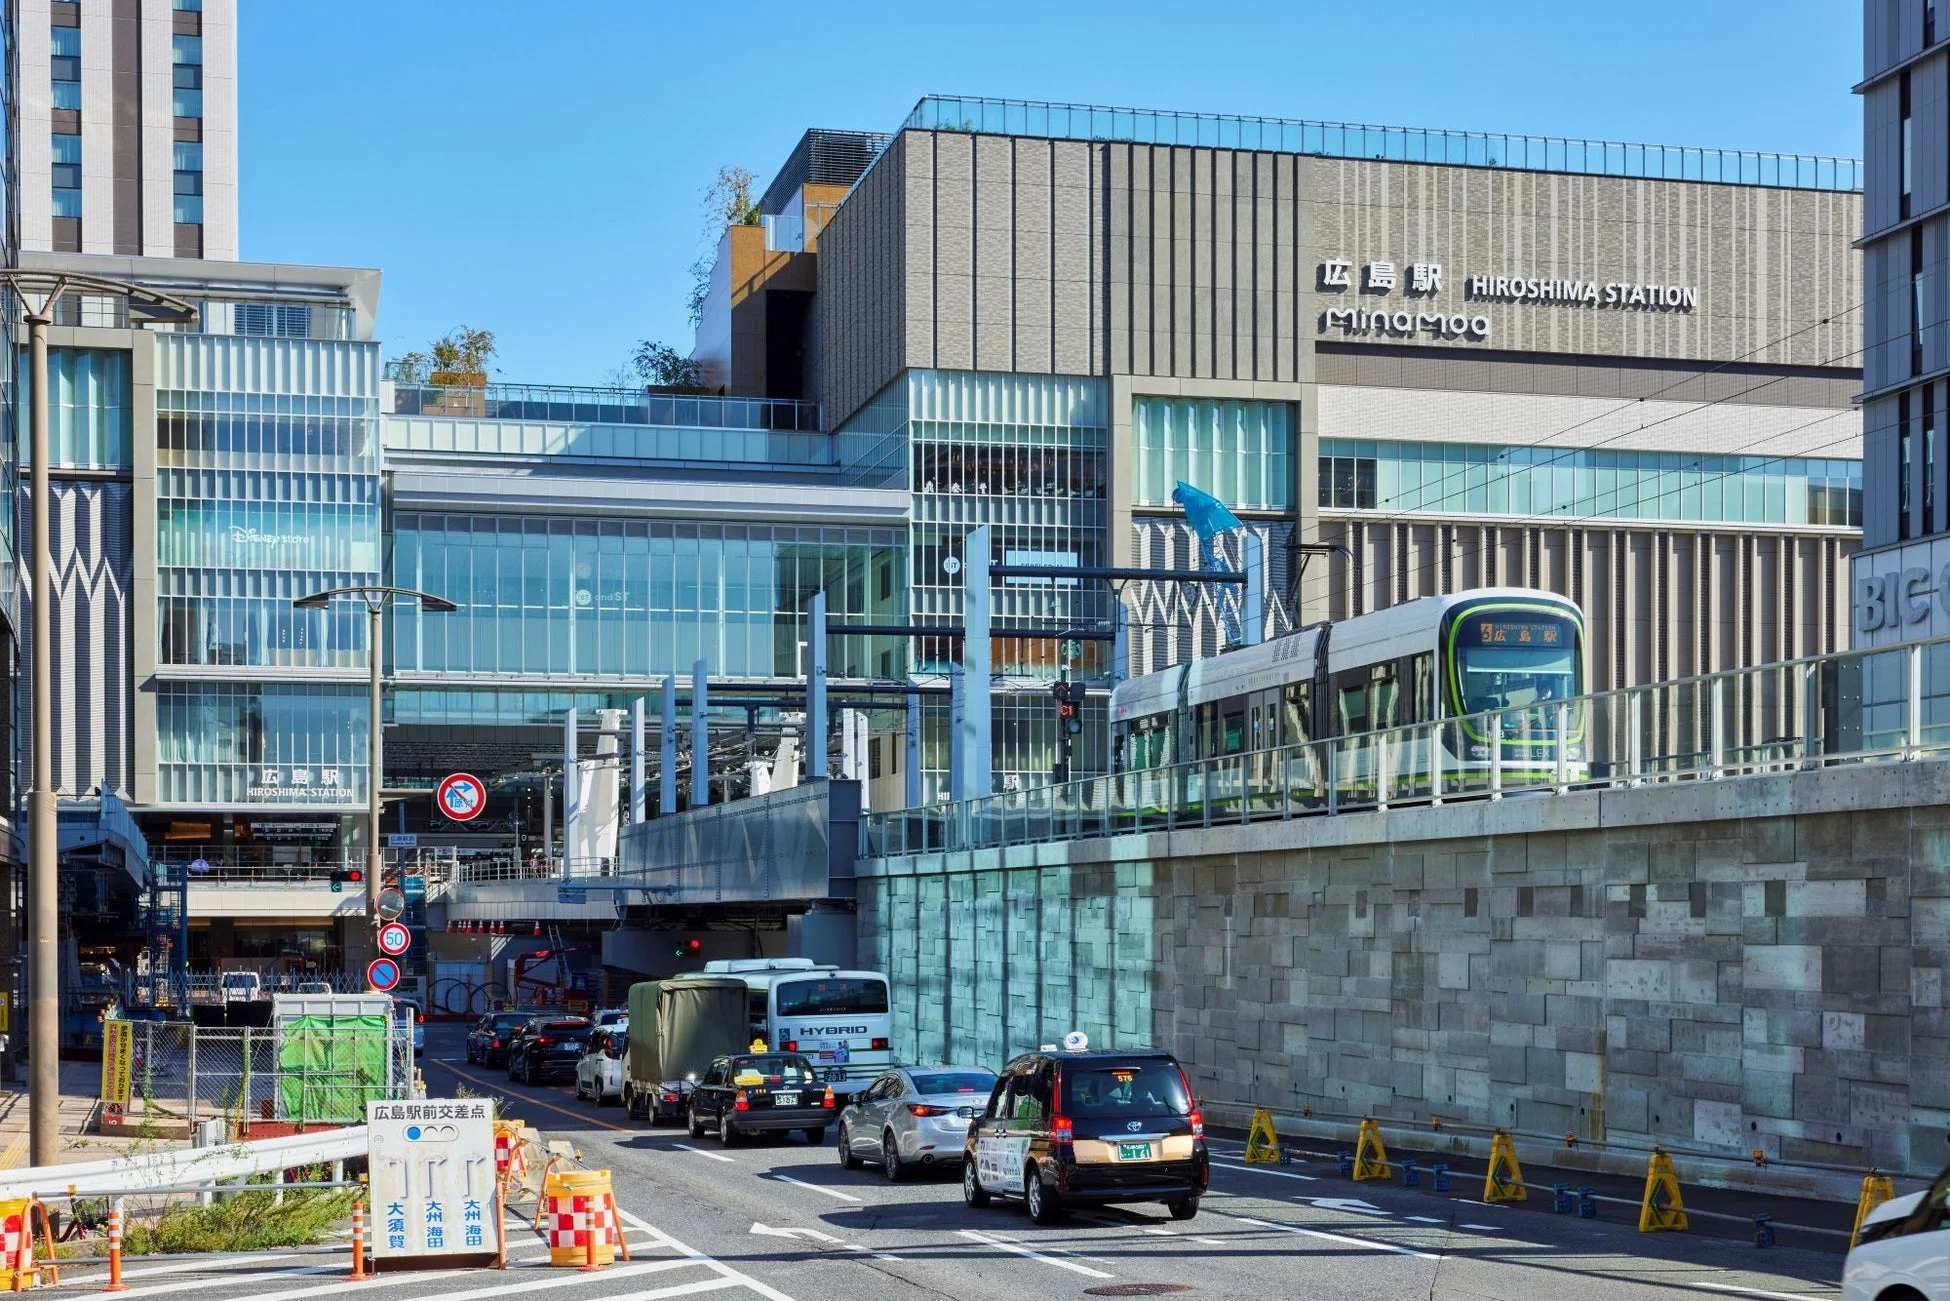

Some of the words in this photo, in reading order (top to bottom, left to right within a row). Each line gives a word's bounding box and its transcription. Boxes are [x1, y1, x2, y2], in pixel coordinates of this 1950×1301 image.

[1323, 258, 1443, 292] 広島駅
[1472, 274, 1600, 302] HIROSHIMA
[1605, 282, 1698, 307] STATION
[1856, 567, 1930, 632] BIC
[1494, 629, 1557, 642] 広島駅
[261, 769, 339, 785] 広島駅
[246, 787, 307, 797] HIROSHIMA
[310, 788, 353, 798] STATION
[386, 931, 403, 946] 50
[800, 1025, 868, 1036] HYBRID
[373, 1104, 486, 1121] 広島駅前交差点
[425, 1201, 443, 1223] 大州
[464, 1199, 481, 1221] 大州
[387, 1202, 406, 1249] 大須賀
[465, 1224, 483, 1246] 海田
[426, 1226, 444, 1248] 海田
